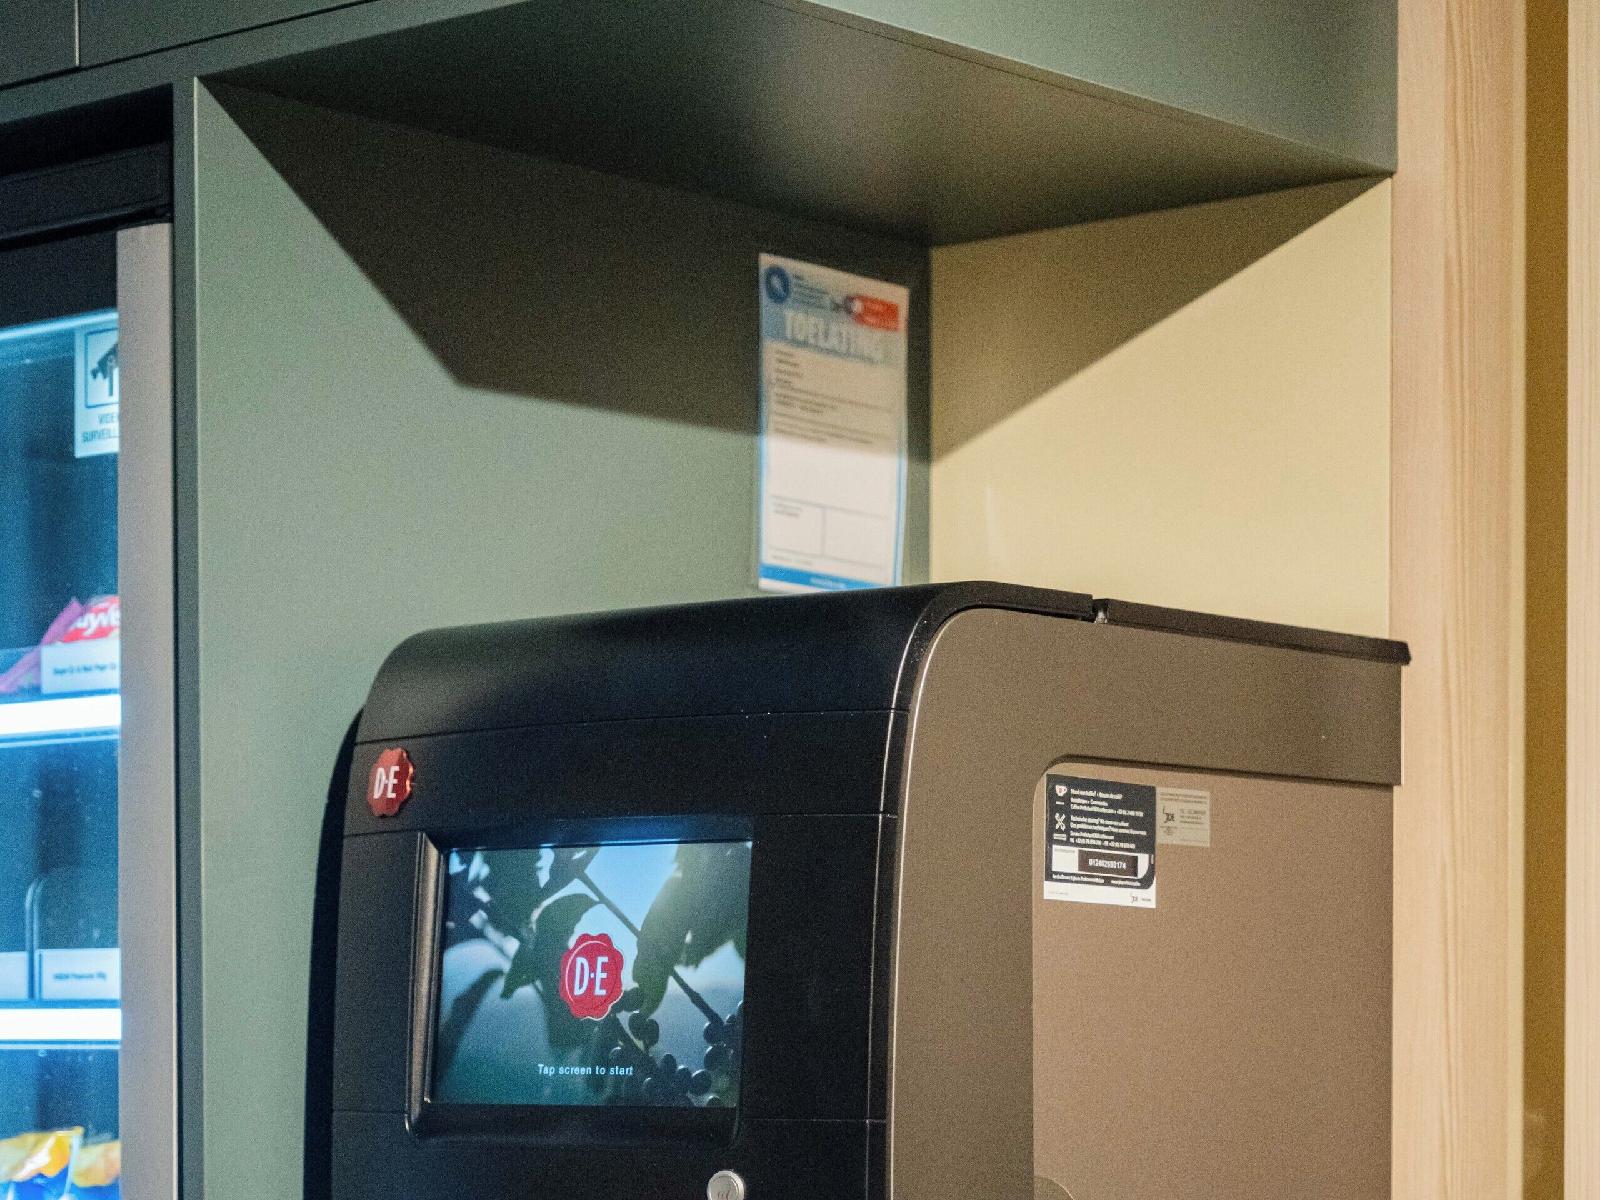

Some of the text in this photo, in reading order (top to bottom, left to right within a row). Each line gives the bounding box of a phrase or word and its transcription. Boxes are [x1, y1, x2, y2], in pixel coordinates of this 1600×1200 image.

[97, 412, 119, 425] VIDE
[537, 1063, 634, 1076] Tap screen to start
